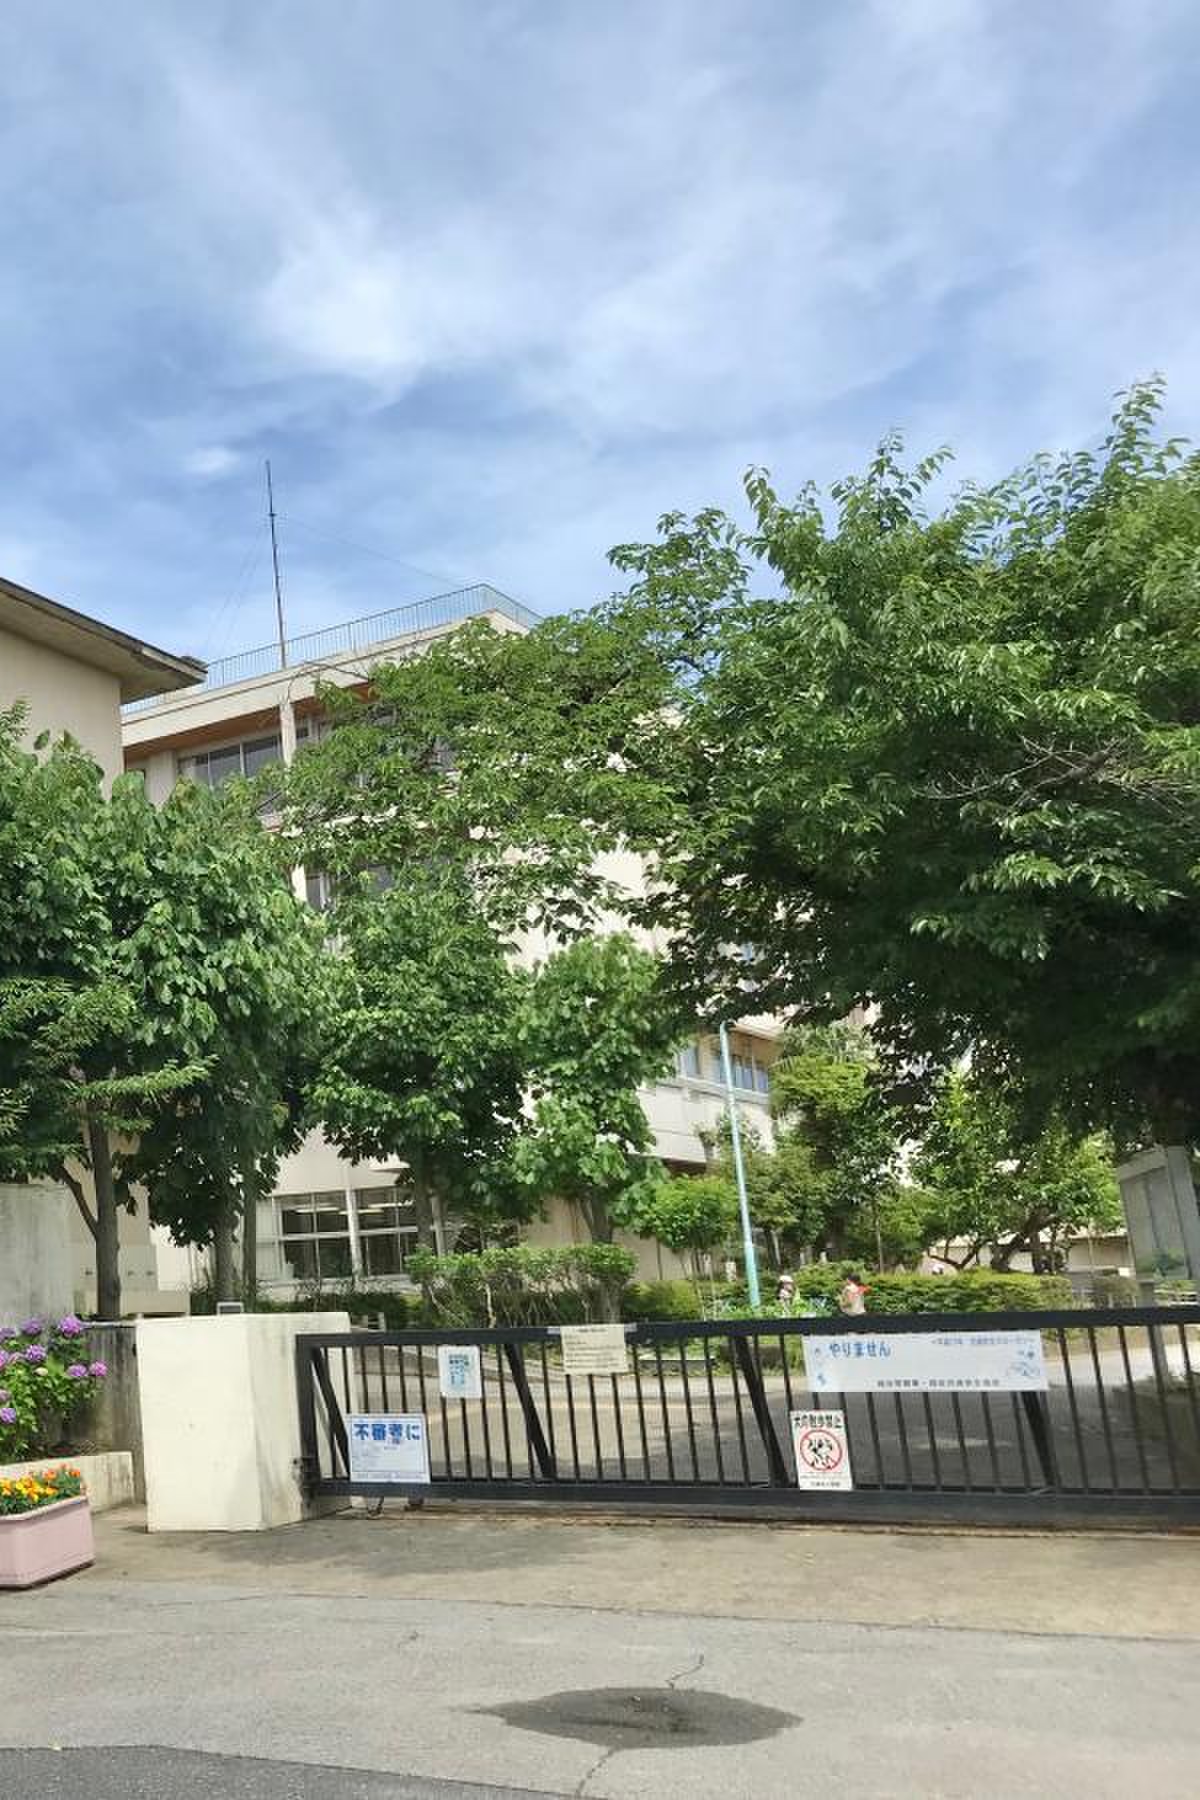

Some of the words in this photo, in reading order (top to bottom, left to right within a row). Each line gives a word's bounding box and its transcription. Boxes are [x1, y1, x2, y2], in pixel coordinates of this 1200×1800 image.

[830, 1341, 891, 1358] やりません
[353, 1422, 420, 1441] 不審者に
